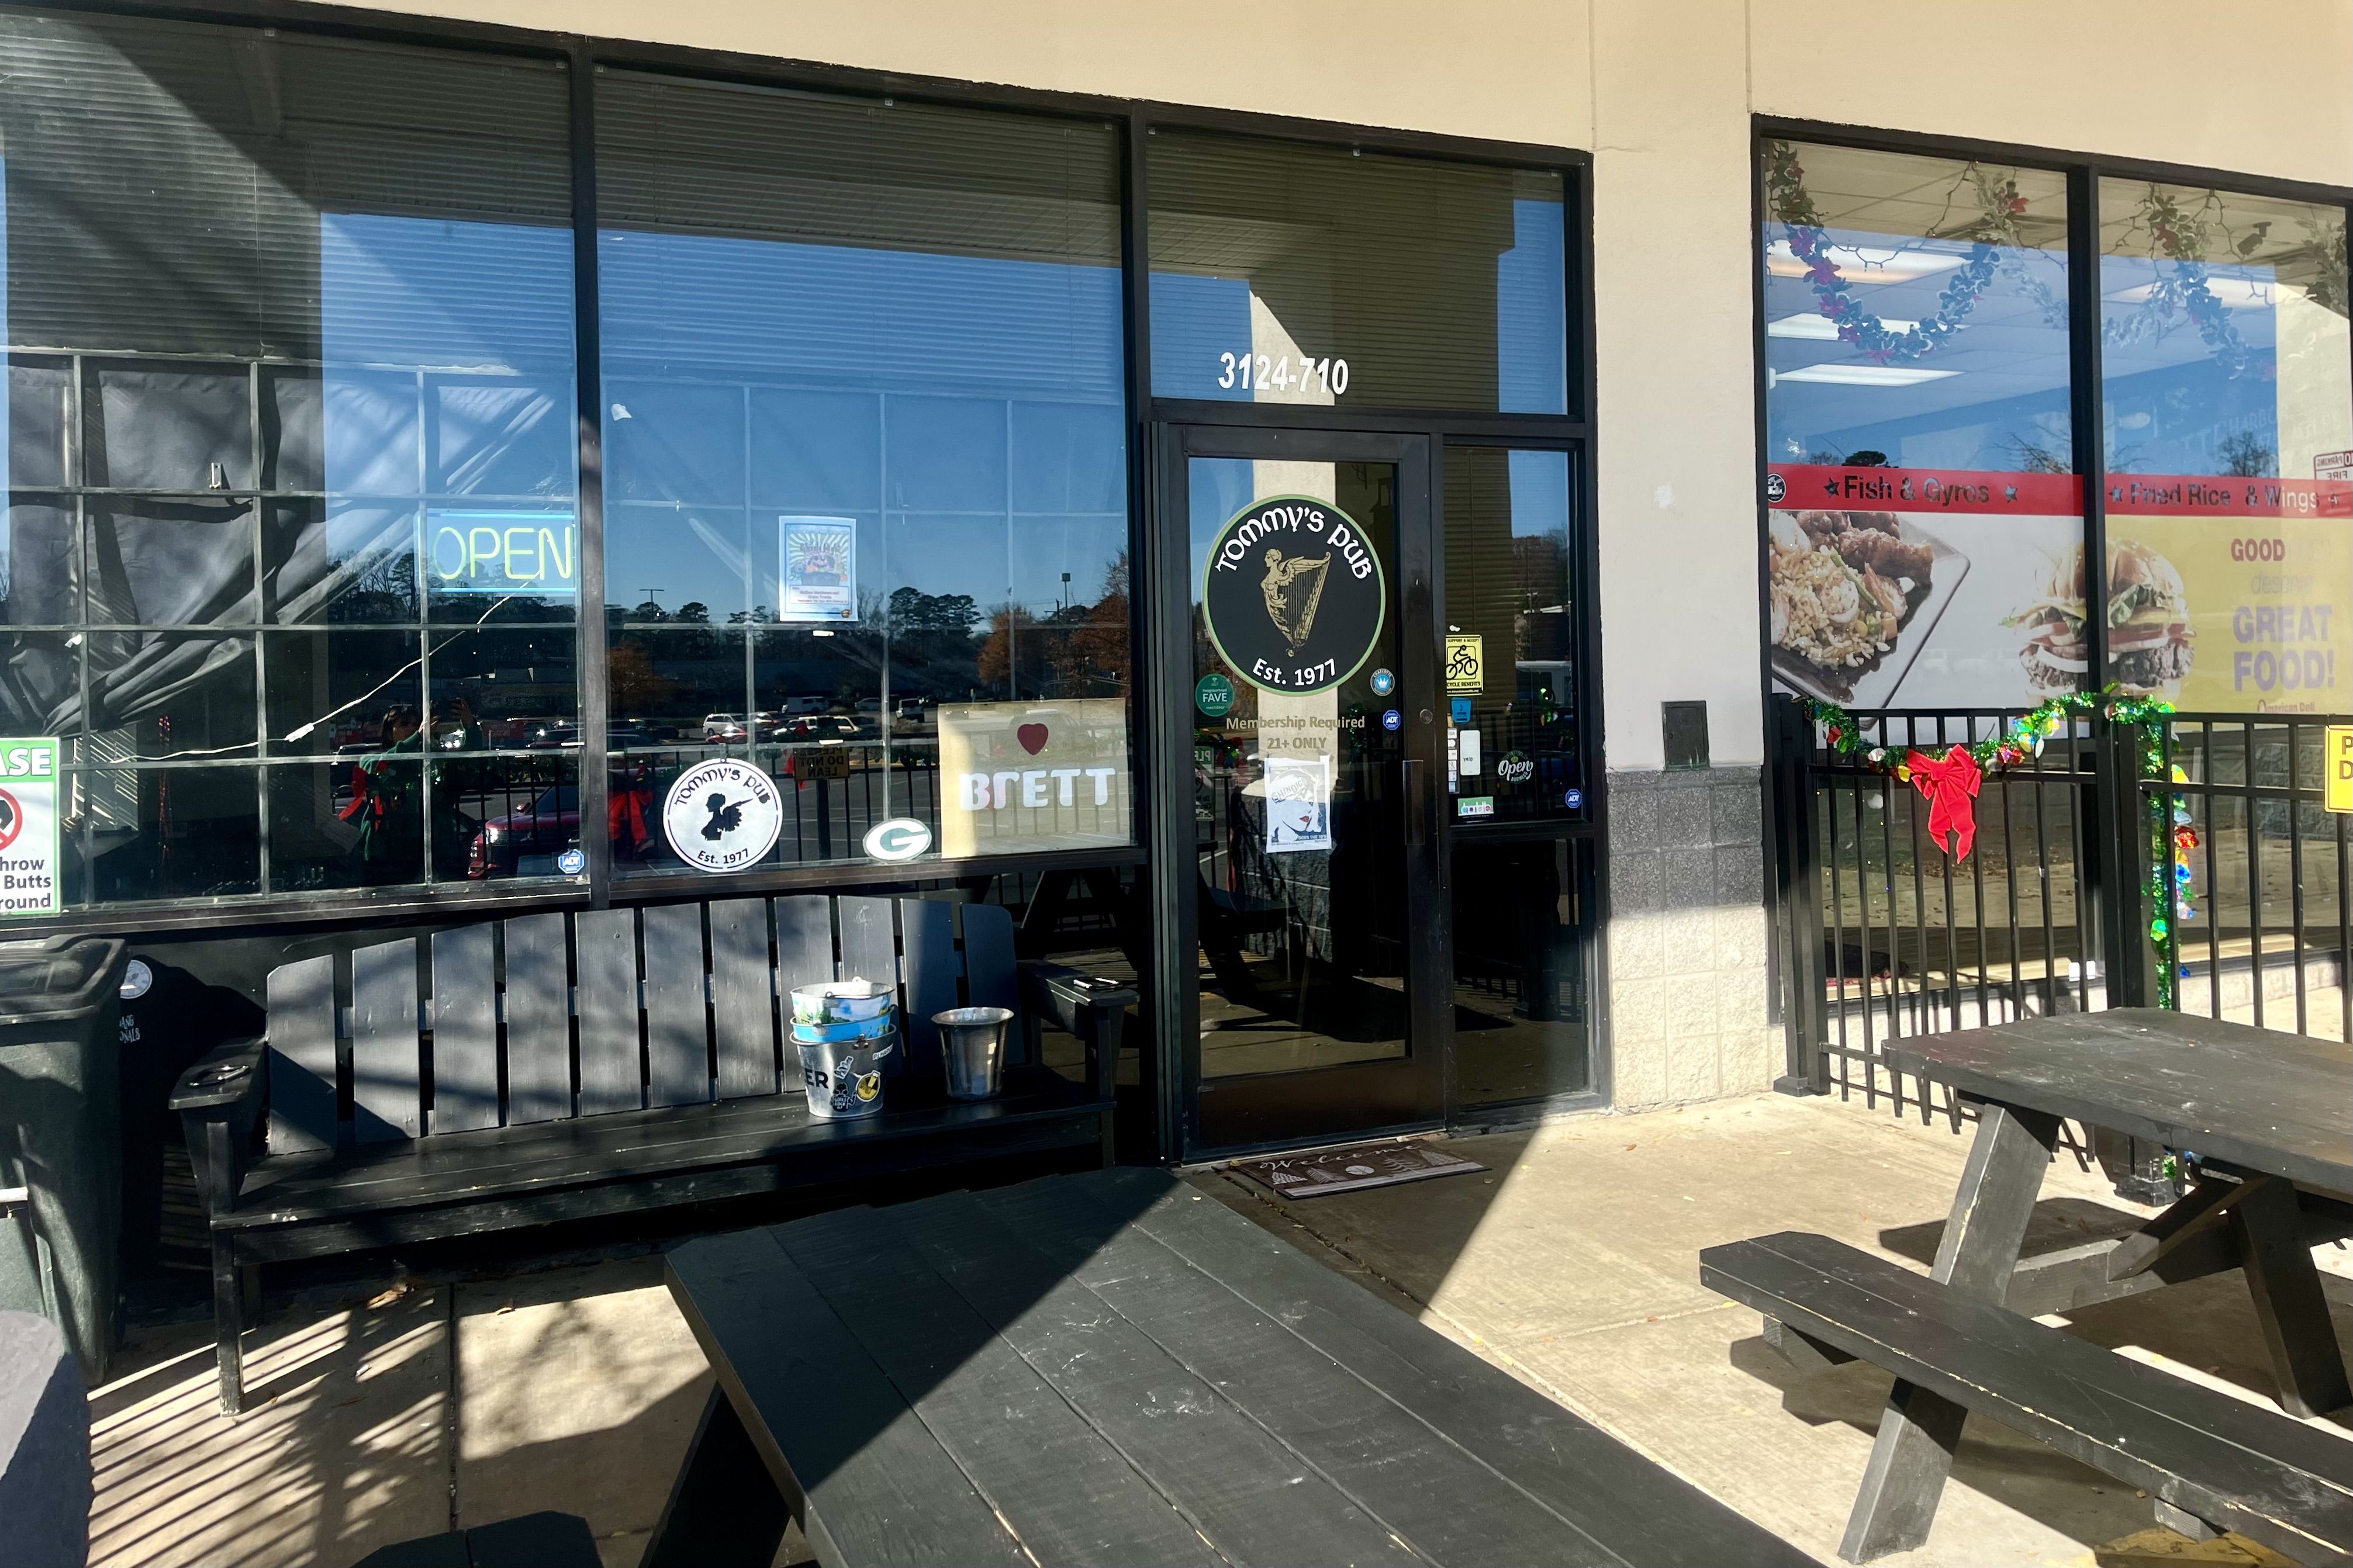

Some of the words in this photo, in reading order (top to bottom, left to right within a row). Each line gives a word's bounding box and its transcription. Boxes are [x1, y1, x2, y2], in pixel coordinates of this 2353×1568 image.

[1218, 352, 1349, 395] 3124-710
[1844, 475, 1892, 500] Fish
[1900, 477, 1917, 501] &
[1924, 477, 1989, 507] Gyros
[2131, 482, 2181, 506] Fried
[2188, 483, 2231, 506] Rice
[2245, 485, 2258, 507] &
[2264, 485, 2320, 513] Wings
[431, 527, 572, 580] OPEN
[2231, 538, 2286, 562] GOOD
[2233, 604, 2333, 643] GREAT
[1253, 658, 1287, 686] Est.
[1294, 658, 1335, 686] 1977
[2233, 649, 2334, 692] FOOD!
[1203, 693, 1228, 702] FAVE
[1226, 715, 1306, 731] Membership
[1309, 715, 1365, 731] Required
[1267, 738, 1290, 749] 21+
[1293, 737, 1326, 749] ONLY
[1498, 760, 1533, 781] Open
[563, 856, 579, 866] ADT
[697, 850, 718, 864] Est.
[723, 848, 749, 864] 1977
[4, 874, 51, 889] Butts
[1260, 1145, 1421, 1171] Welcome
